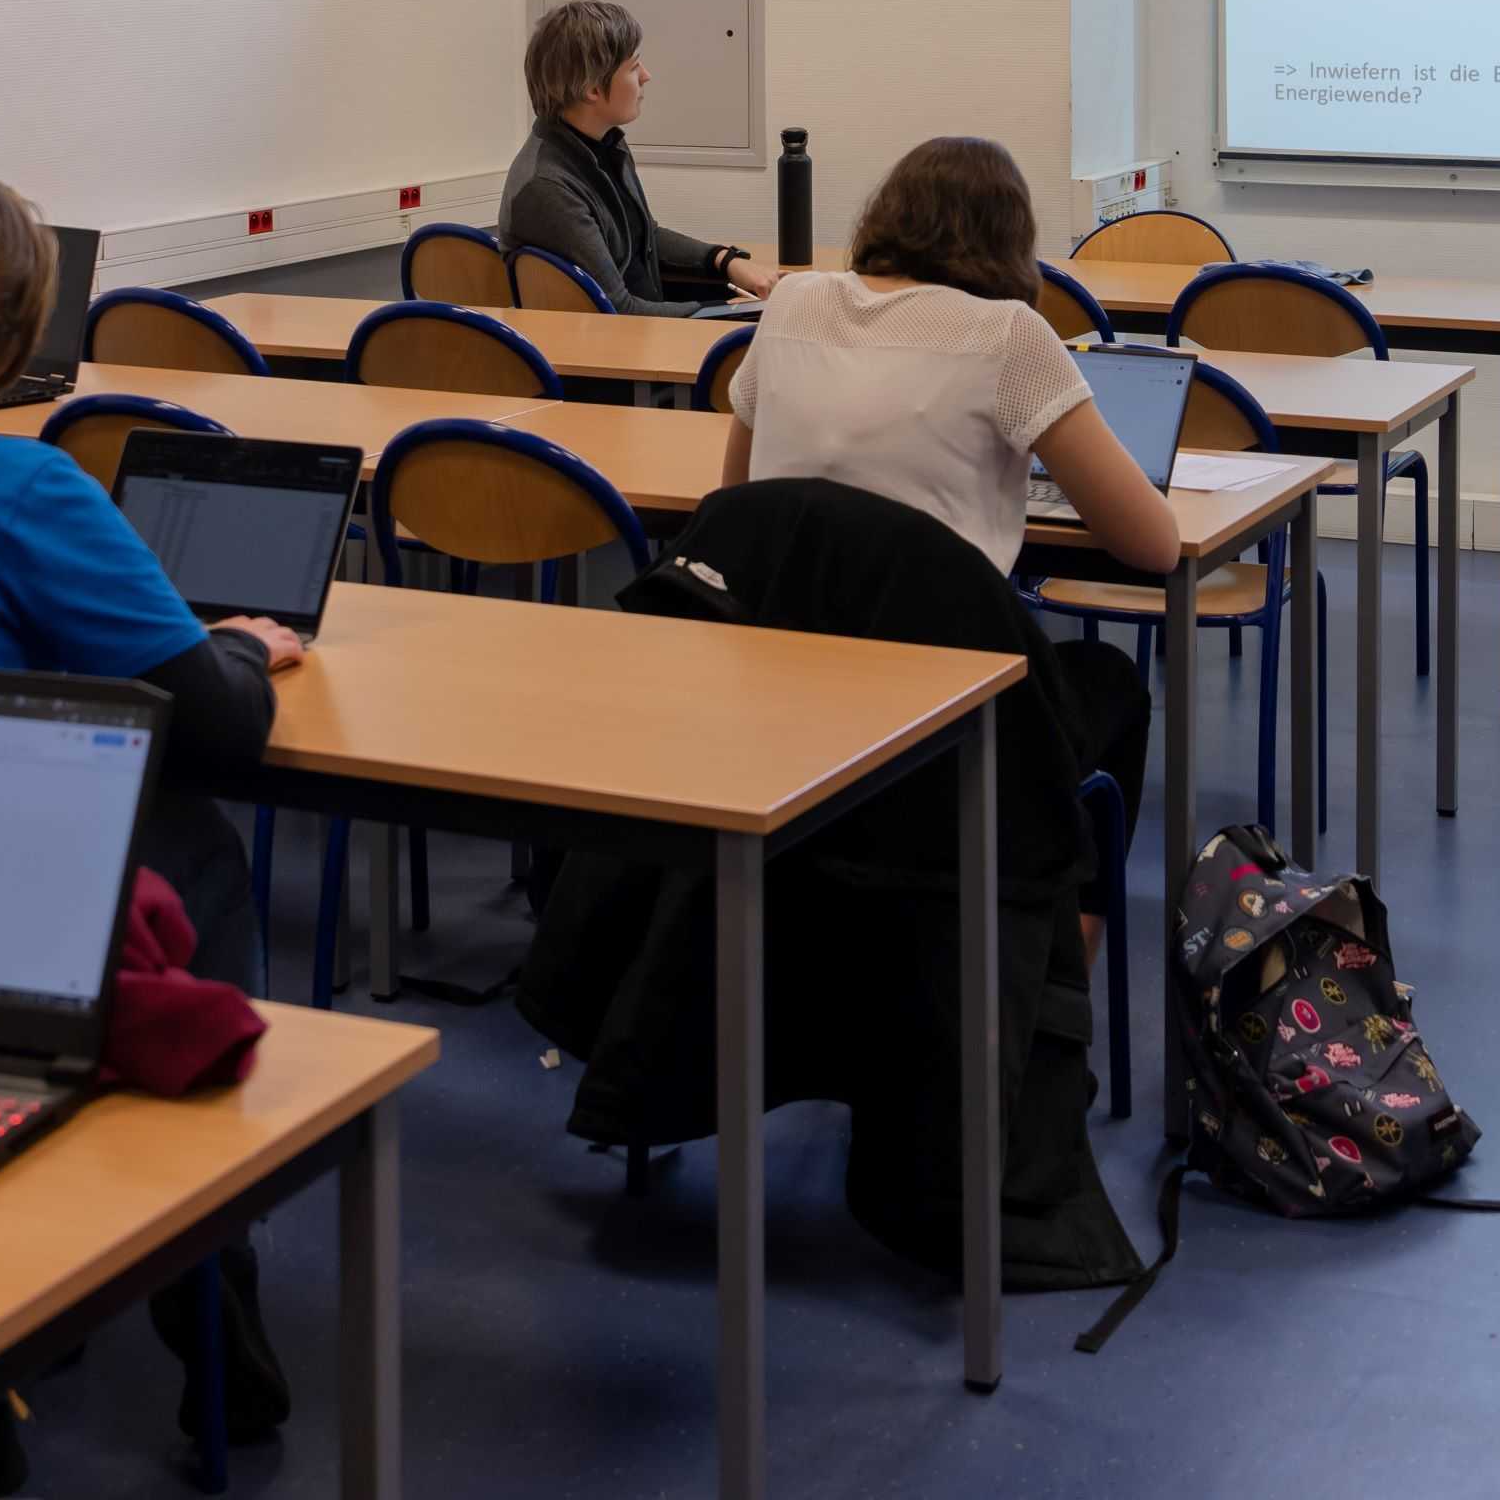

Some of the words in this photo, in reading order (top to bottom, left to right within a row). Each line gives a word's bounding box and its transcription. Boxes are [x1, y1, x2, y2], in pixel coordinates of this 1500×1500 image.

[1310, 61, 1401, 82] Inwiefern
[1413, 63, 1437, 82] ist
[1449, 62, 1480, 83] die
[1275, 83, 1423, 106] Energiewende?
